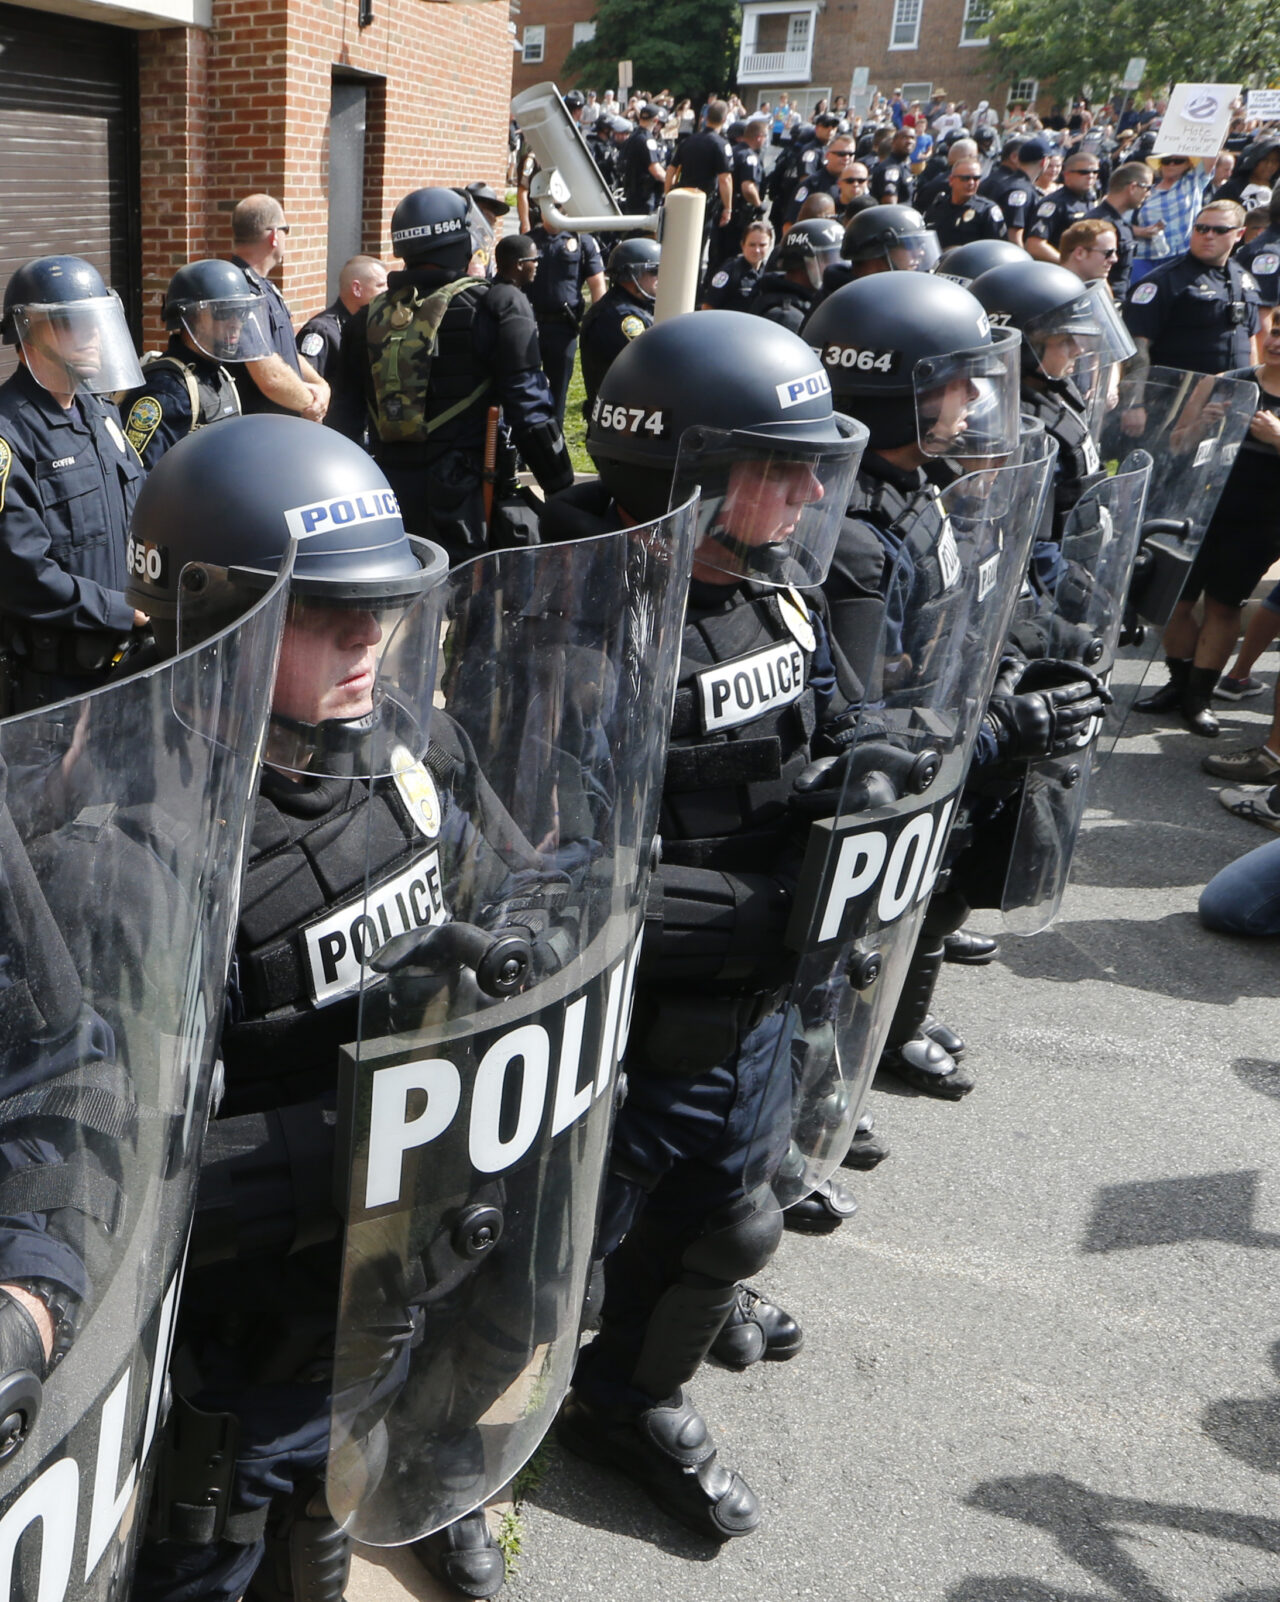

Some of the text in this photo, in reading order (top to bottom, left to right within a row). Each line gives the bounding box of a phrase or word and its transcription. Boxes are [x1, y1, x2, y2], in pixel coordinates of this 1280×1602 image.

[434, 219, 462, 235] 5564
[787, 232, 809, 246] 1946
[825, 345, 892, 373] 3064
[600, 404, 664, 435] 5674
[711, 650, 801, 719] POLICE
